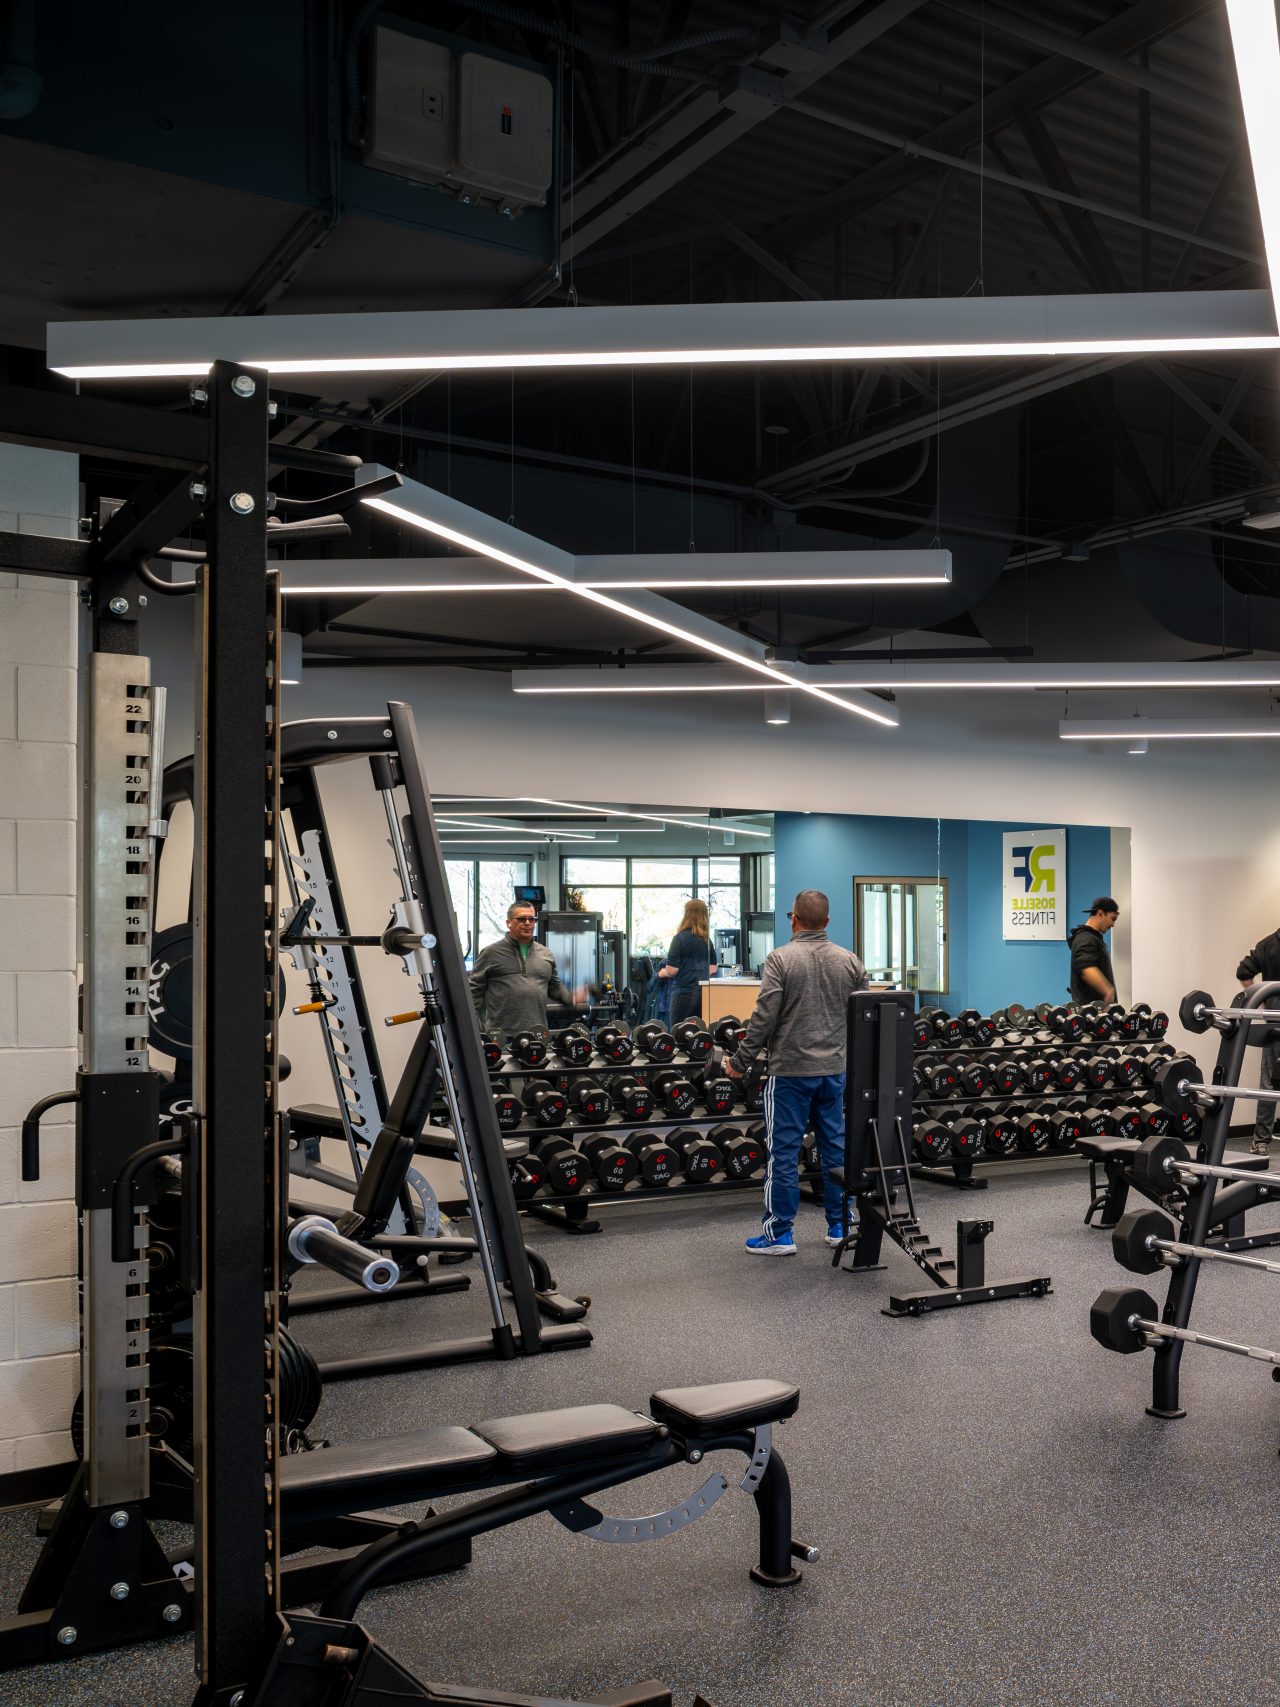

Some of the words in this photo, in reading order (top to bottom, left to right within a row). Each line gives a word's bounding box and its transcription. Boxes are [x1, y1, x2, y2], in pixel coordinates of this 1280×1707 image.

[126, 704, 142, 713] 22
[125, 775, 141, 784] 20
[126, 846, 140, 854] 18
[126, 987, 140, 995] 14
[148, 959, 171, 1023] TAG
[621, 1040, 630, 1050] TAG
[969, 1069, 981, 1078] TAG
[675, 1092, 688, 1106] 27.5
[680, 1097, 695, 1110] TAG
[1091, 1118, 1105, 1128] TAG
[1159, 1120, 1168, 1134] TAG
[1185, 1122, 1196, 1133] TAG
[932, 1137, 940, 1146] 80
[968, 1135, 974, 1144] 80
[1004, 1133, 1016, 1148] TAG
[1035, 1133, 1048, 1146] TAG
[938, 1137, 950, 1153] TAG
[560, 1160, 579, 1168] TAG
[701, 1158, 708, 1168] 65
[732, 1157, 742, 1173] TAG
[742, 1156, 750, 1165] 65
[566, 1168, 576, 1177] 55
[653, 1172, 670, 1180] TAG
[129, 1268, 137, 1277] 6
[129, 1339, 137, 1348] 4
[130, 1410, 137, 1418] 2
